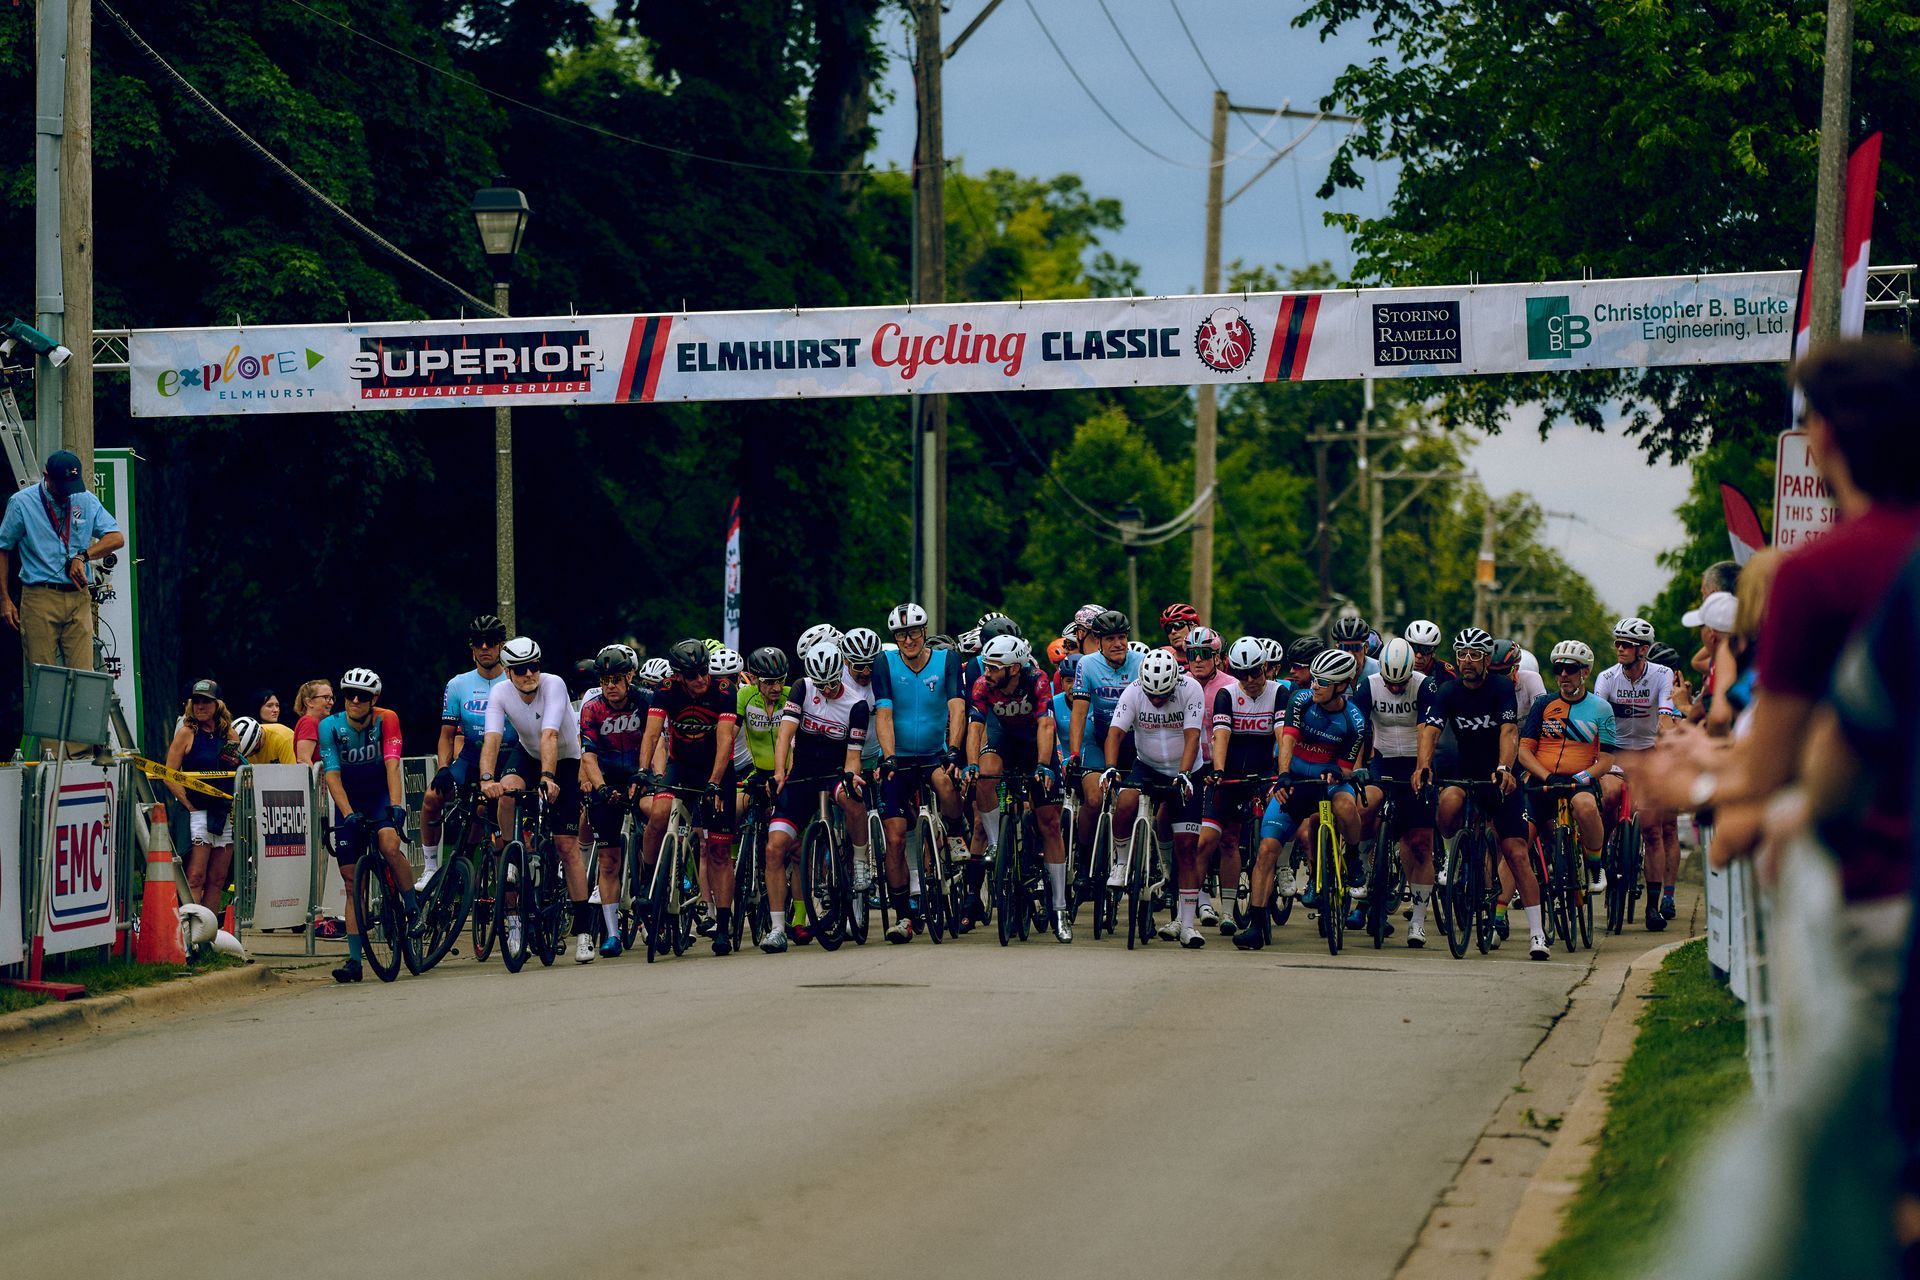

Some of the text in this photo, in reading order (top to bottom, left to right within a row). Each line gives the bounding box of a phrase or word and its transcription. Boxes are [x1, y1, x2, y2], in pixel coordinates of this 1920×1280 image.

[1378, 308, 1450, 323] STORINO
[1594, 297, 1788, 323] Christopher B. Burke
[1378, 327, 1457, 343] RAMELLO
[1643, 316, 1788, 343] Engineering, Ltd.
[677, 322, 1180, 380] ELMHURST Cycling CLASSIC
[350, 344, 604, 380] SUPERIOR
[219, 388, 315, 400] ELMHURST
[365, 382, 586, 398] AMBULANCE SERVICE
[1783, 475, 1826, 498] PARK
[1785, 506, 1813, 521] THIS
[1781, 530, 1796, 544] OF
[1617, 689, 1650, 698] CLEVELAND
[993, 694, 1032, 716] 606
[1372, 700, 1418, 713] DONKEY
[600, 708, 640, 735] 606
[747, 711, 763, 720] FORT
[1139, 711, 1184, 723] CLEVELAND
[1348, 708, 1365, 760] FLATLANDIA
[262, 806, 307, 836] SUPERIOR
[1185, 823, 1199, 832] CCA
